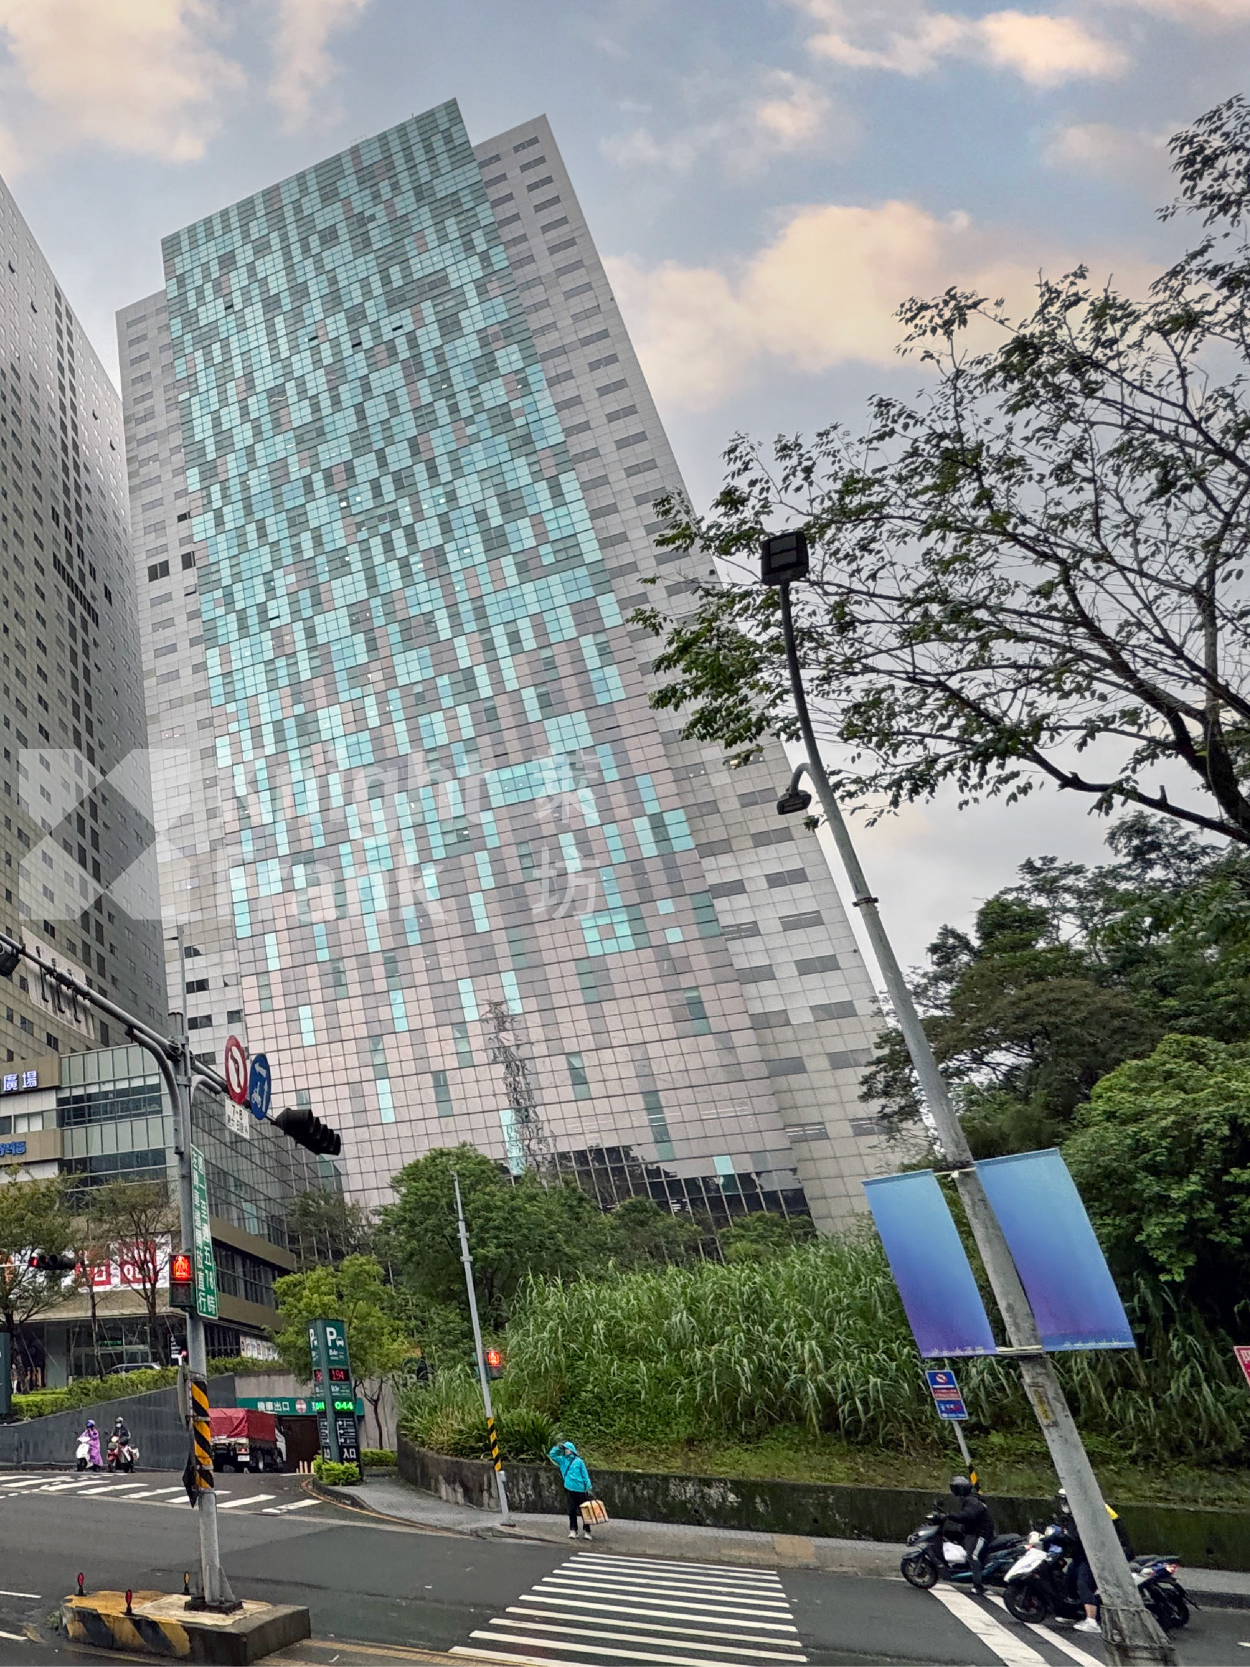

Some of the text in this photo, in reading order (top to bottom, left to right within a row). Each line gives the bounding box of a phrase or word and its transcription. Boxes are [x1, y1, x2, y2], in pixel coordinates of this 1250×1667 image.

[326, 1326, 337, 1347] P
[257, 1401, 290, 1411] 機車出口
[334, 1401, 354, 1410] 044
[342, 1447, 357, 1459] 入口
